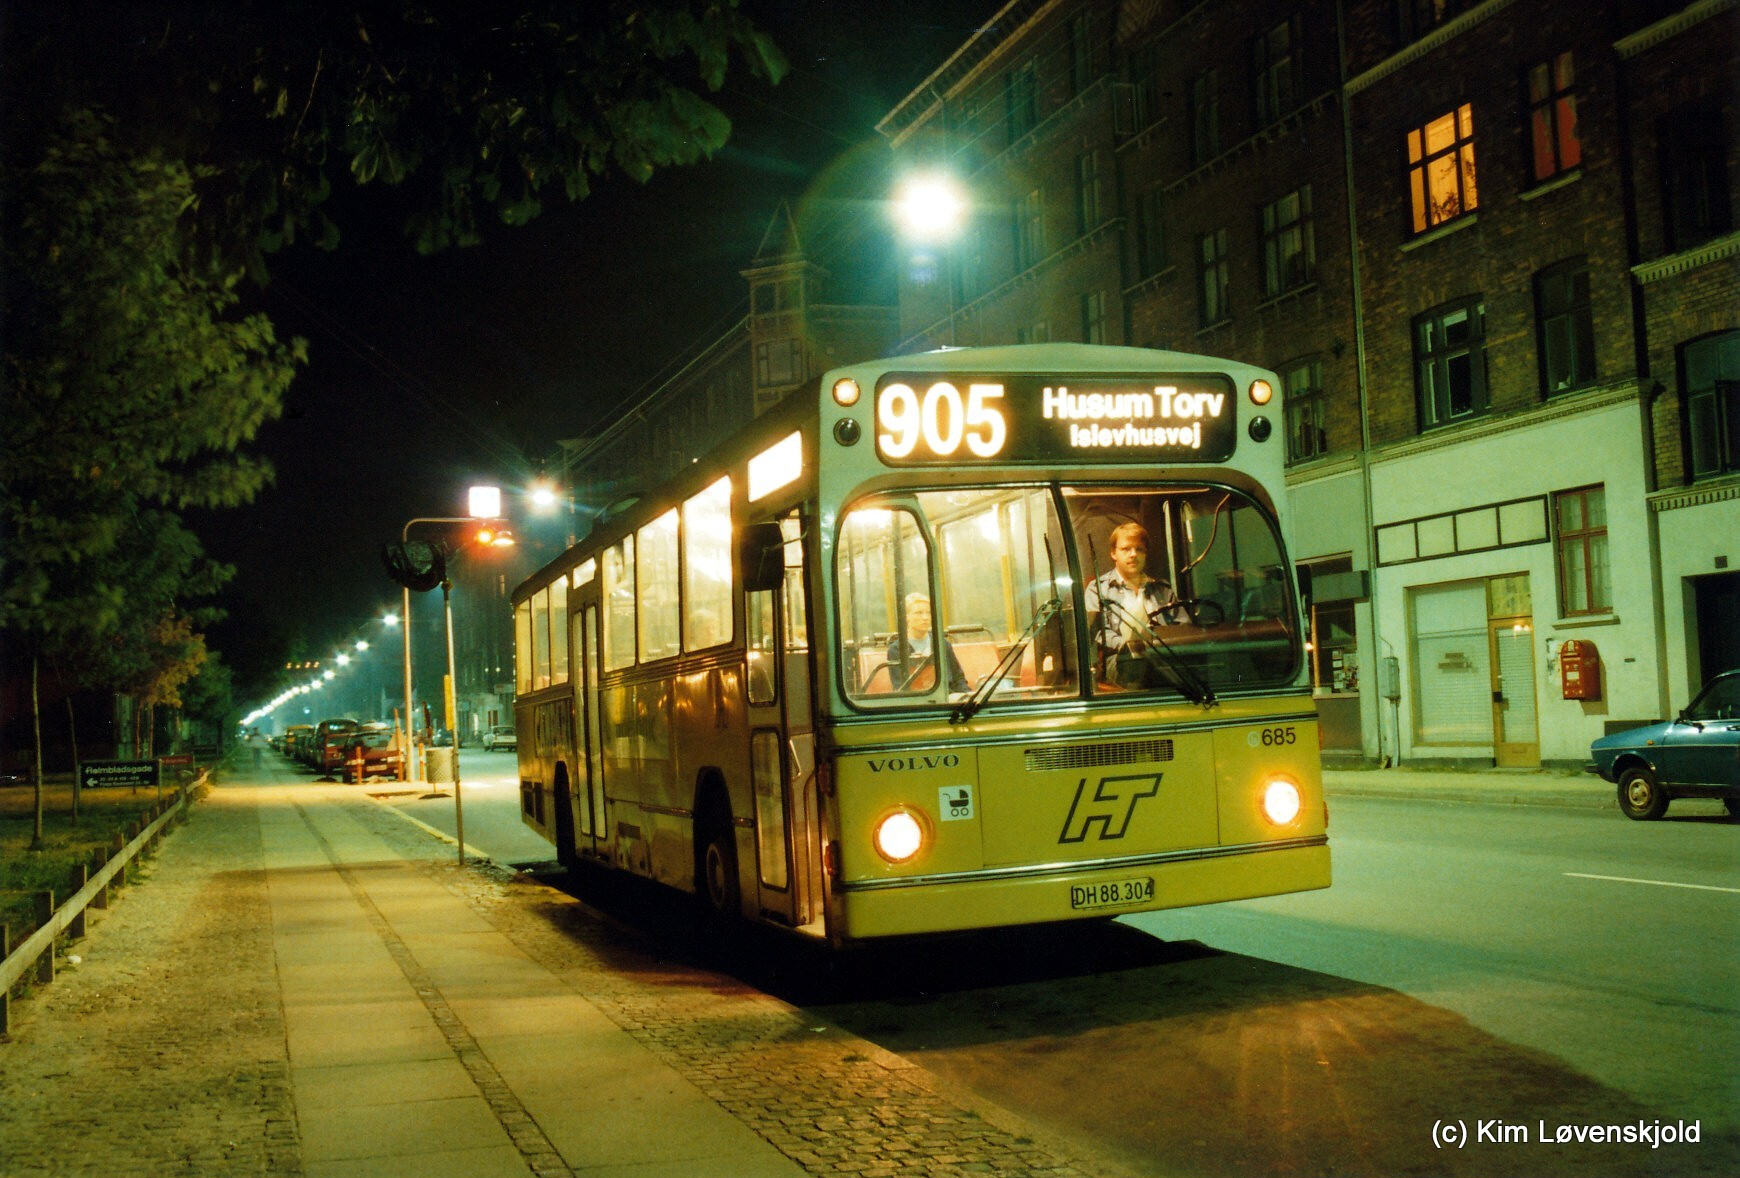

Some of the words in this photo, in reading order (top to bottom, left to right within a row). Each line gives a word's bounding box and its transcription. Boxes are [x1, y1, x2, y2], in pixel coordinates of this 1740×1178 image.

[1043, 386, 1153, 420] Husum
[1154, 386, 1225, 418] Torv
[878, 381, 1007, 459] 905
[1069, 423, 1202, 450] Islevhusvej
[1261, 726, 1297, 747] 685
[867, 755, 960, 773] VOLVO
[1073, 886, 1097, 906] DH
[1100, 881, 1154, 903] 88.304
